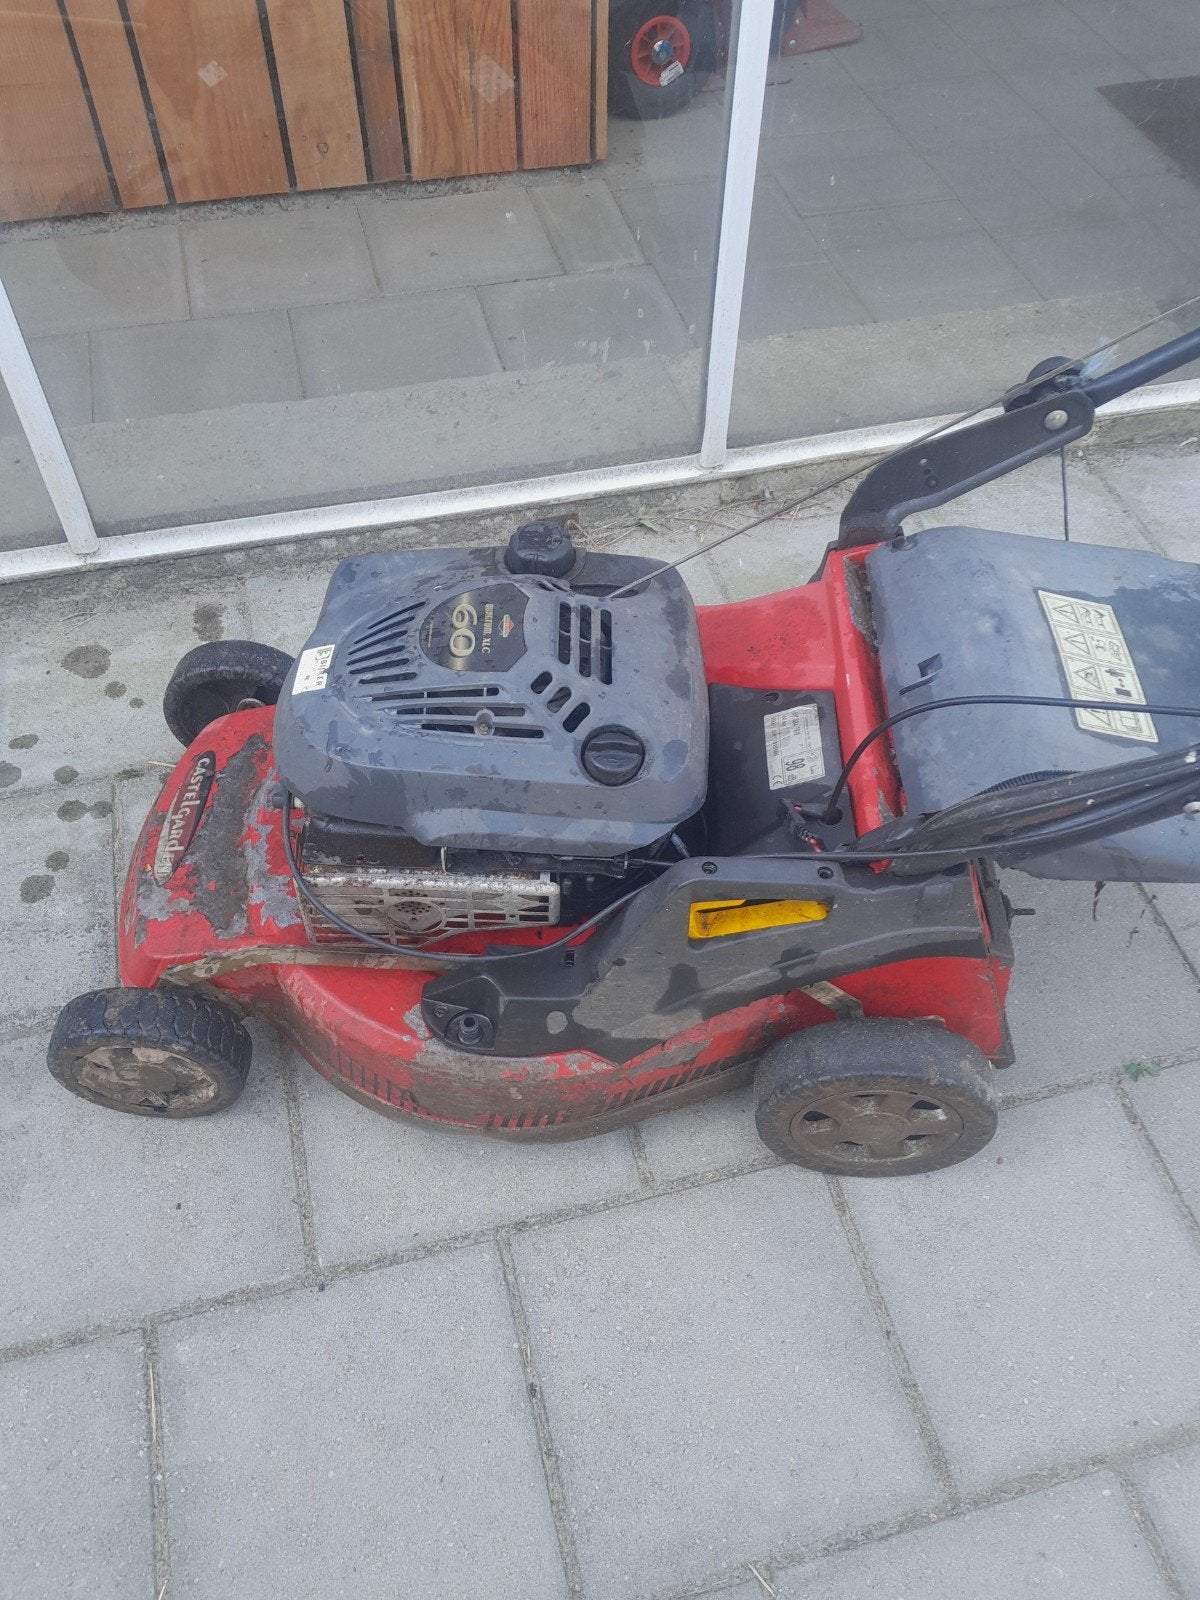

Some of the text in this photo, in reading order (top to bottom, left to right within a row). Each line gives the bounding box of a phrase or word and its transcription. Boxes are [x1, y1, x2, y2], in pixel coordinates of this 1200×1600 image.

[450, 604, 477, 657] 60
[482, 638, 491, 654] XLC
[786, 758, 805, 772] 98
